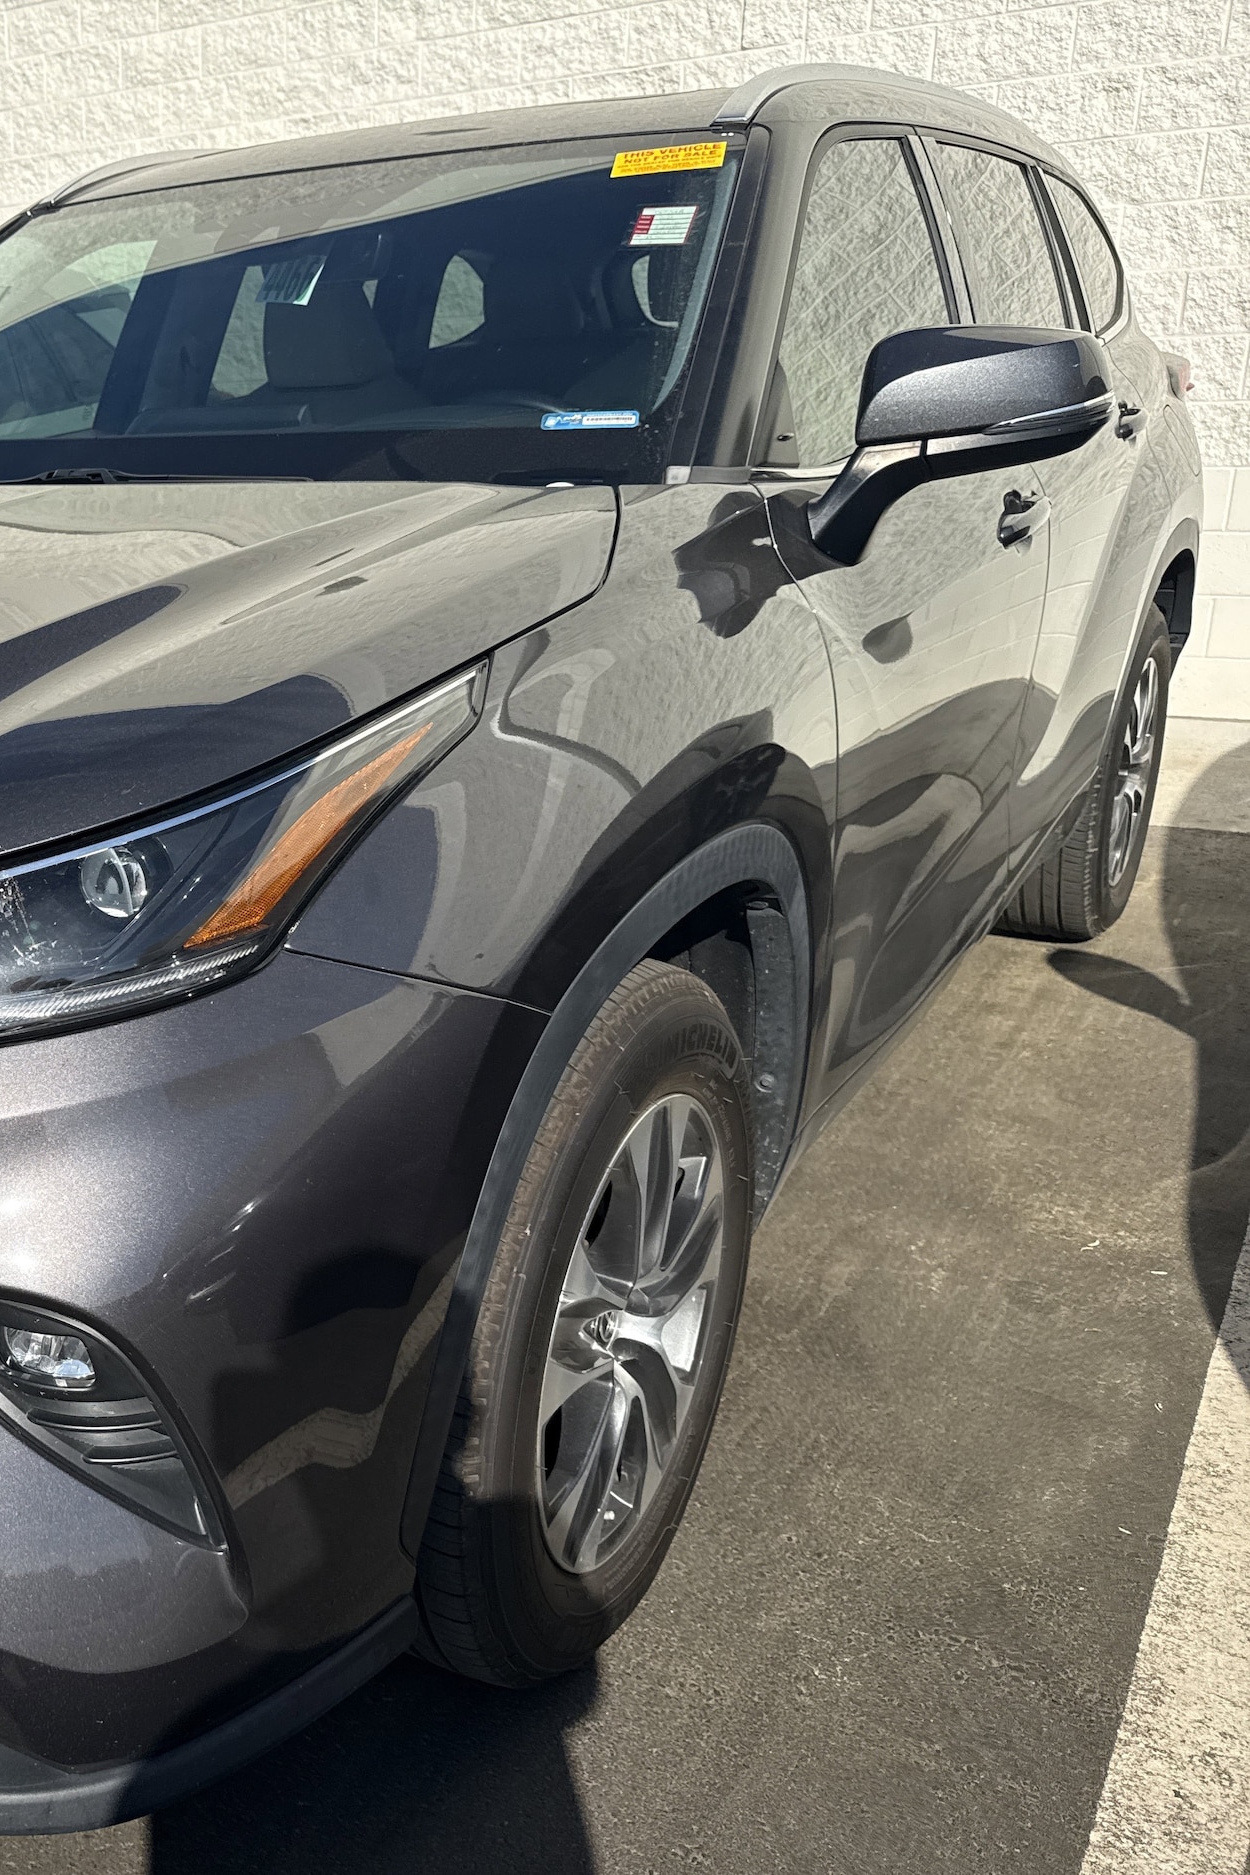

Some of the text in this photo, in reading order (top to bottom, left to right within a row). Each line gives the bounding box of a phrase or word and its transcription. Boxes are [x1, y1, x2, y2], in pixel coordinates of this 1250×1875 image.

[623, 143, 722, 159] THIS VEHICLE
[623, 156, 651, 164] NOT
[653, 153, 680, 161] FOR
[683, 149, 718, 158] SALE
